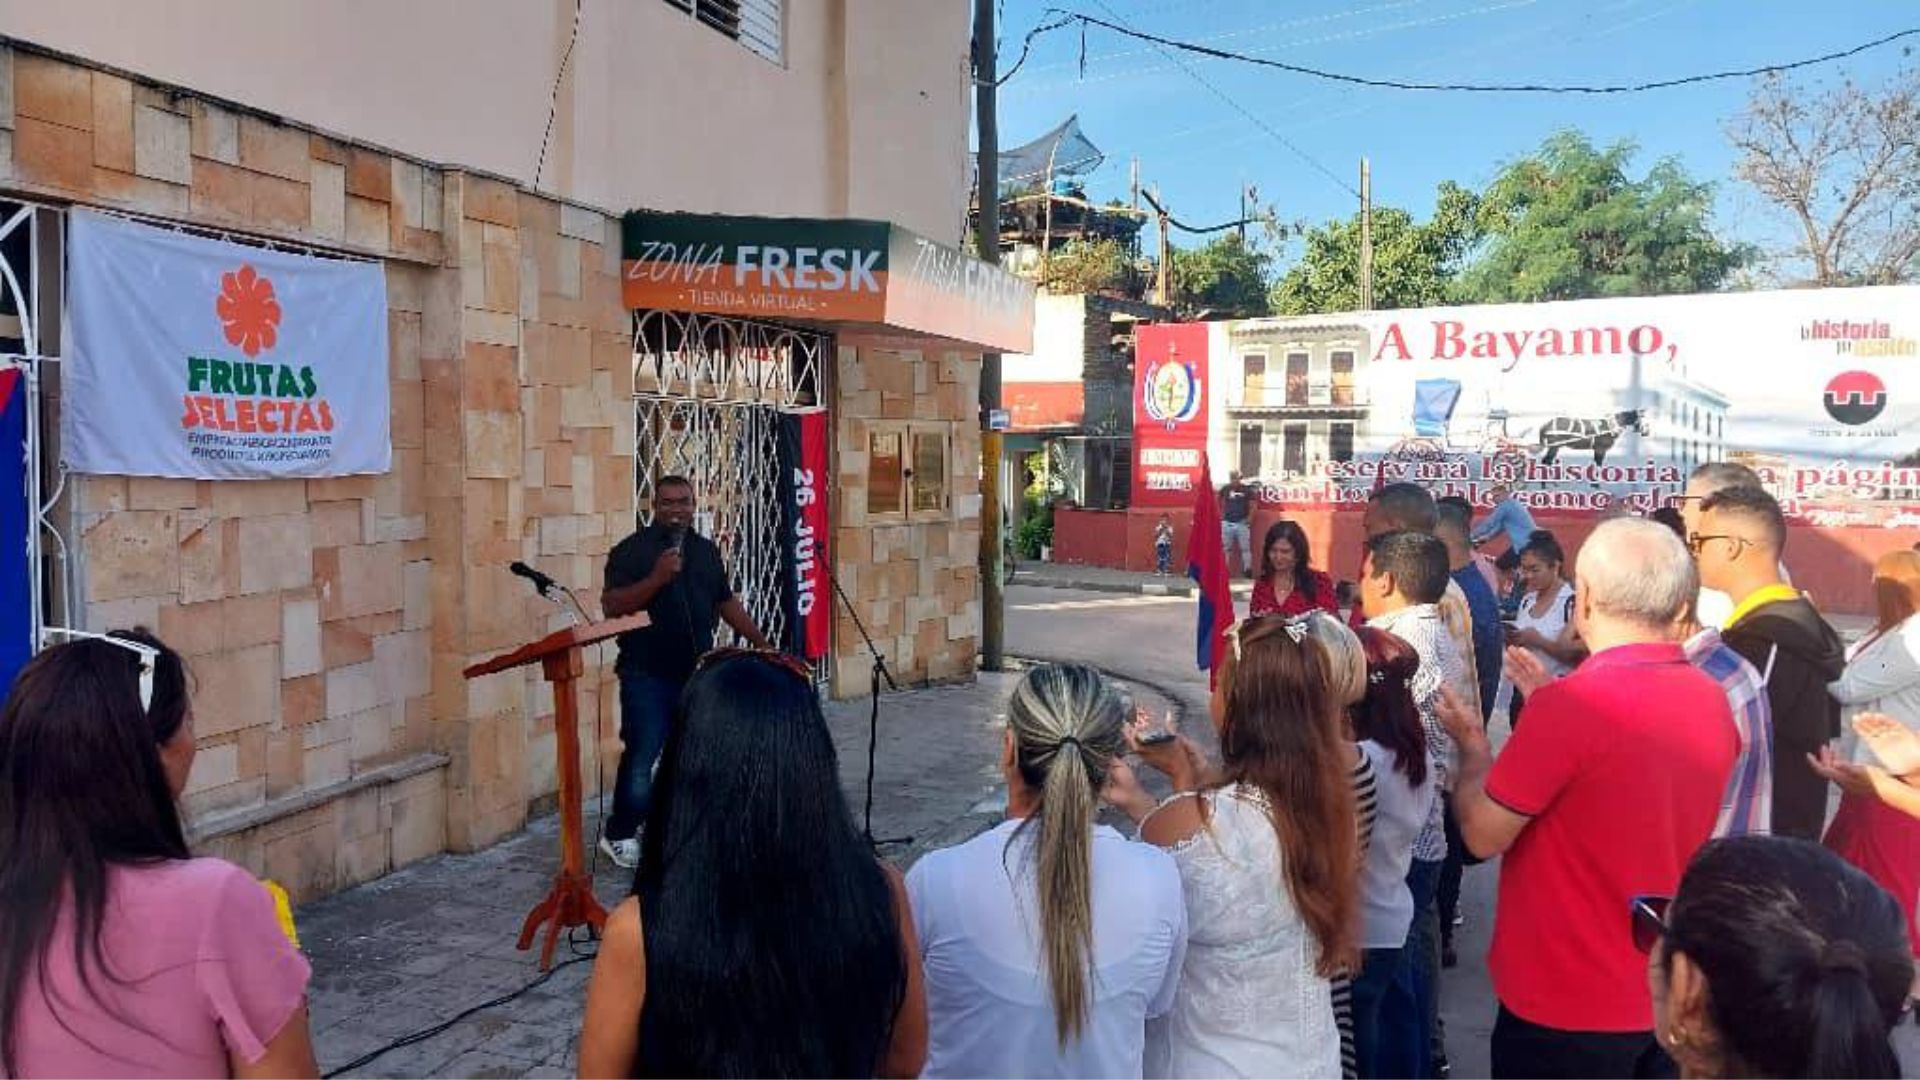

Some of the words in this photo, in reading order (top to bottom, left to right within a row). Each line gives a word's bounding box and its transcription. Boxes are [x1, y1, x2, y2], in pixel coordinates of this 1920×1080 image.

[628, 241, 724, 285] ZONA
[734, 245, 884, 293] FRESK
[688, 289, 745, 307] TIENDA
[750, 293, 815, 312] VIRTUAL
[1372, 322, 1413, 362] A
[1431, 320, 1678, 373] Bayamo,
[1811, 319, 1890, 340] historia
[187, 357, 317, 398] FRUTAS
[182, 396, 334, 434] SELECTAS
[794, 468, 816, 505] 26
[1482, 456, 1515, 480] la
[1524, 457, 1682, 481] historia
[795, 518, 817, 616] JULIO
